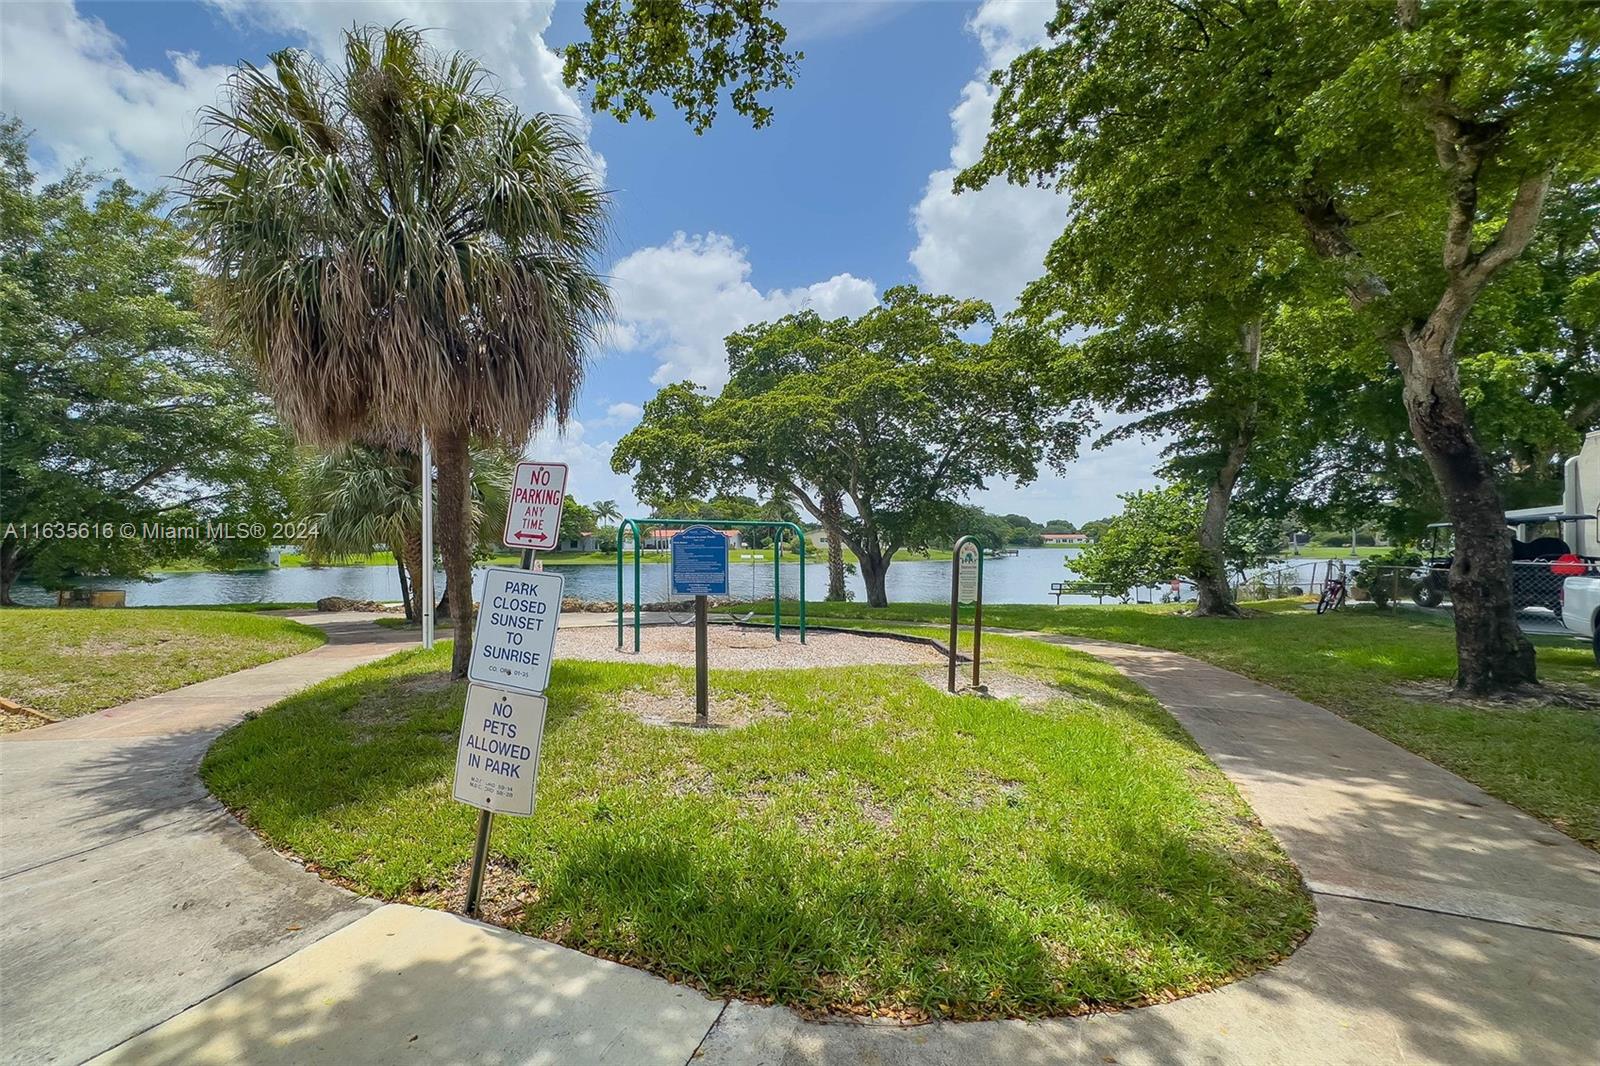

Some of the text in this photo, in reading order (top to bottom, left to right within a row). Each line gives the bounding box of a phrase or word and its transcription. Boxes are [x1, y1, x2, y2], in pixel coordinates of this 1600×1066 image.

[530, 470, 550, 486] NO
[514, 488, 560, 506] PARKING
[524, 506, 545, 517] ANY
[522, 518, 544, 530] TIME
[505, 581, 539, 597] PARK
[493, 596, 547, 615] CLOSED
[490, 612, 544, 632] SUNSET
[506, 631, 523, 645] TO
[483, 645, 540, 666] SUNRISE
[492, 702, 513, 719] NO
[483, 719, 517, 738] PETS
[466, 734, 531, 760] ALLOWED
[468, 753, 521, 779] IN PARK
